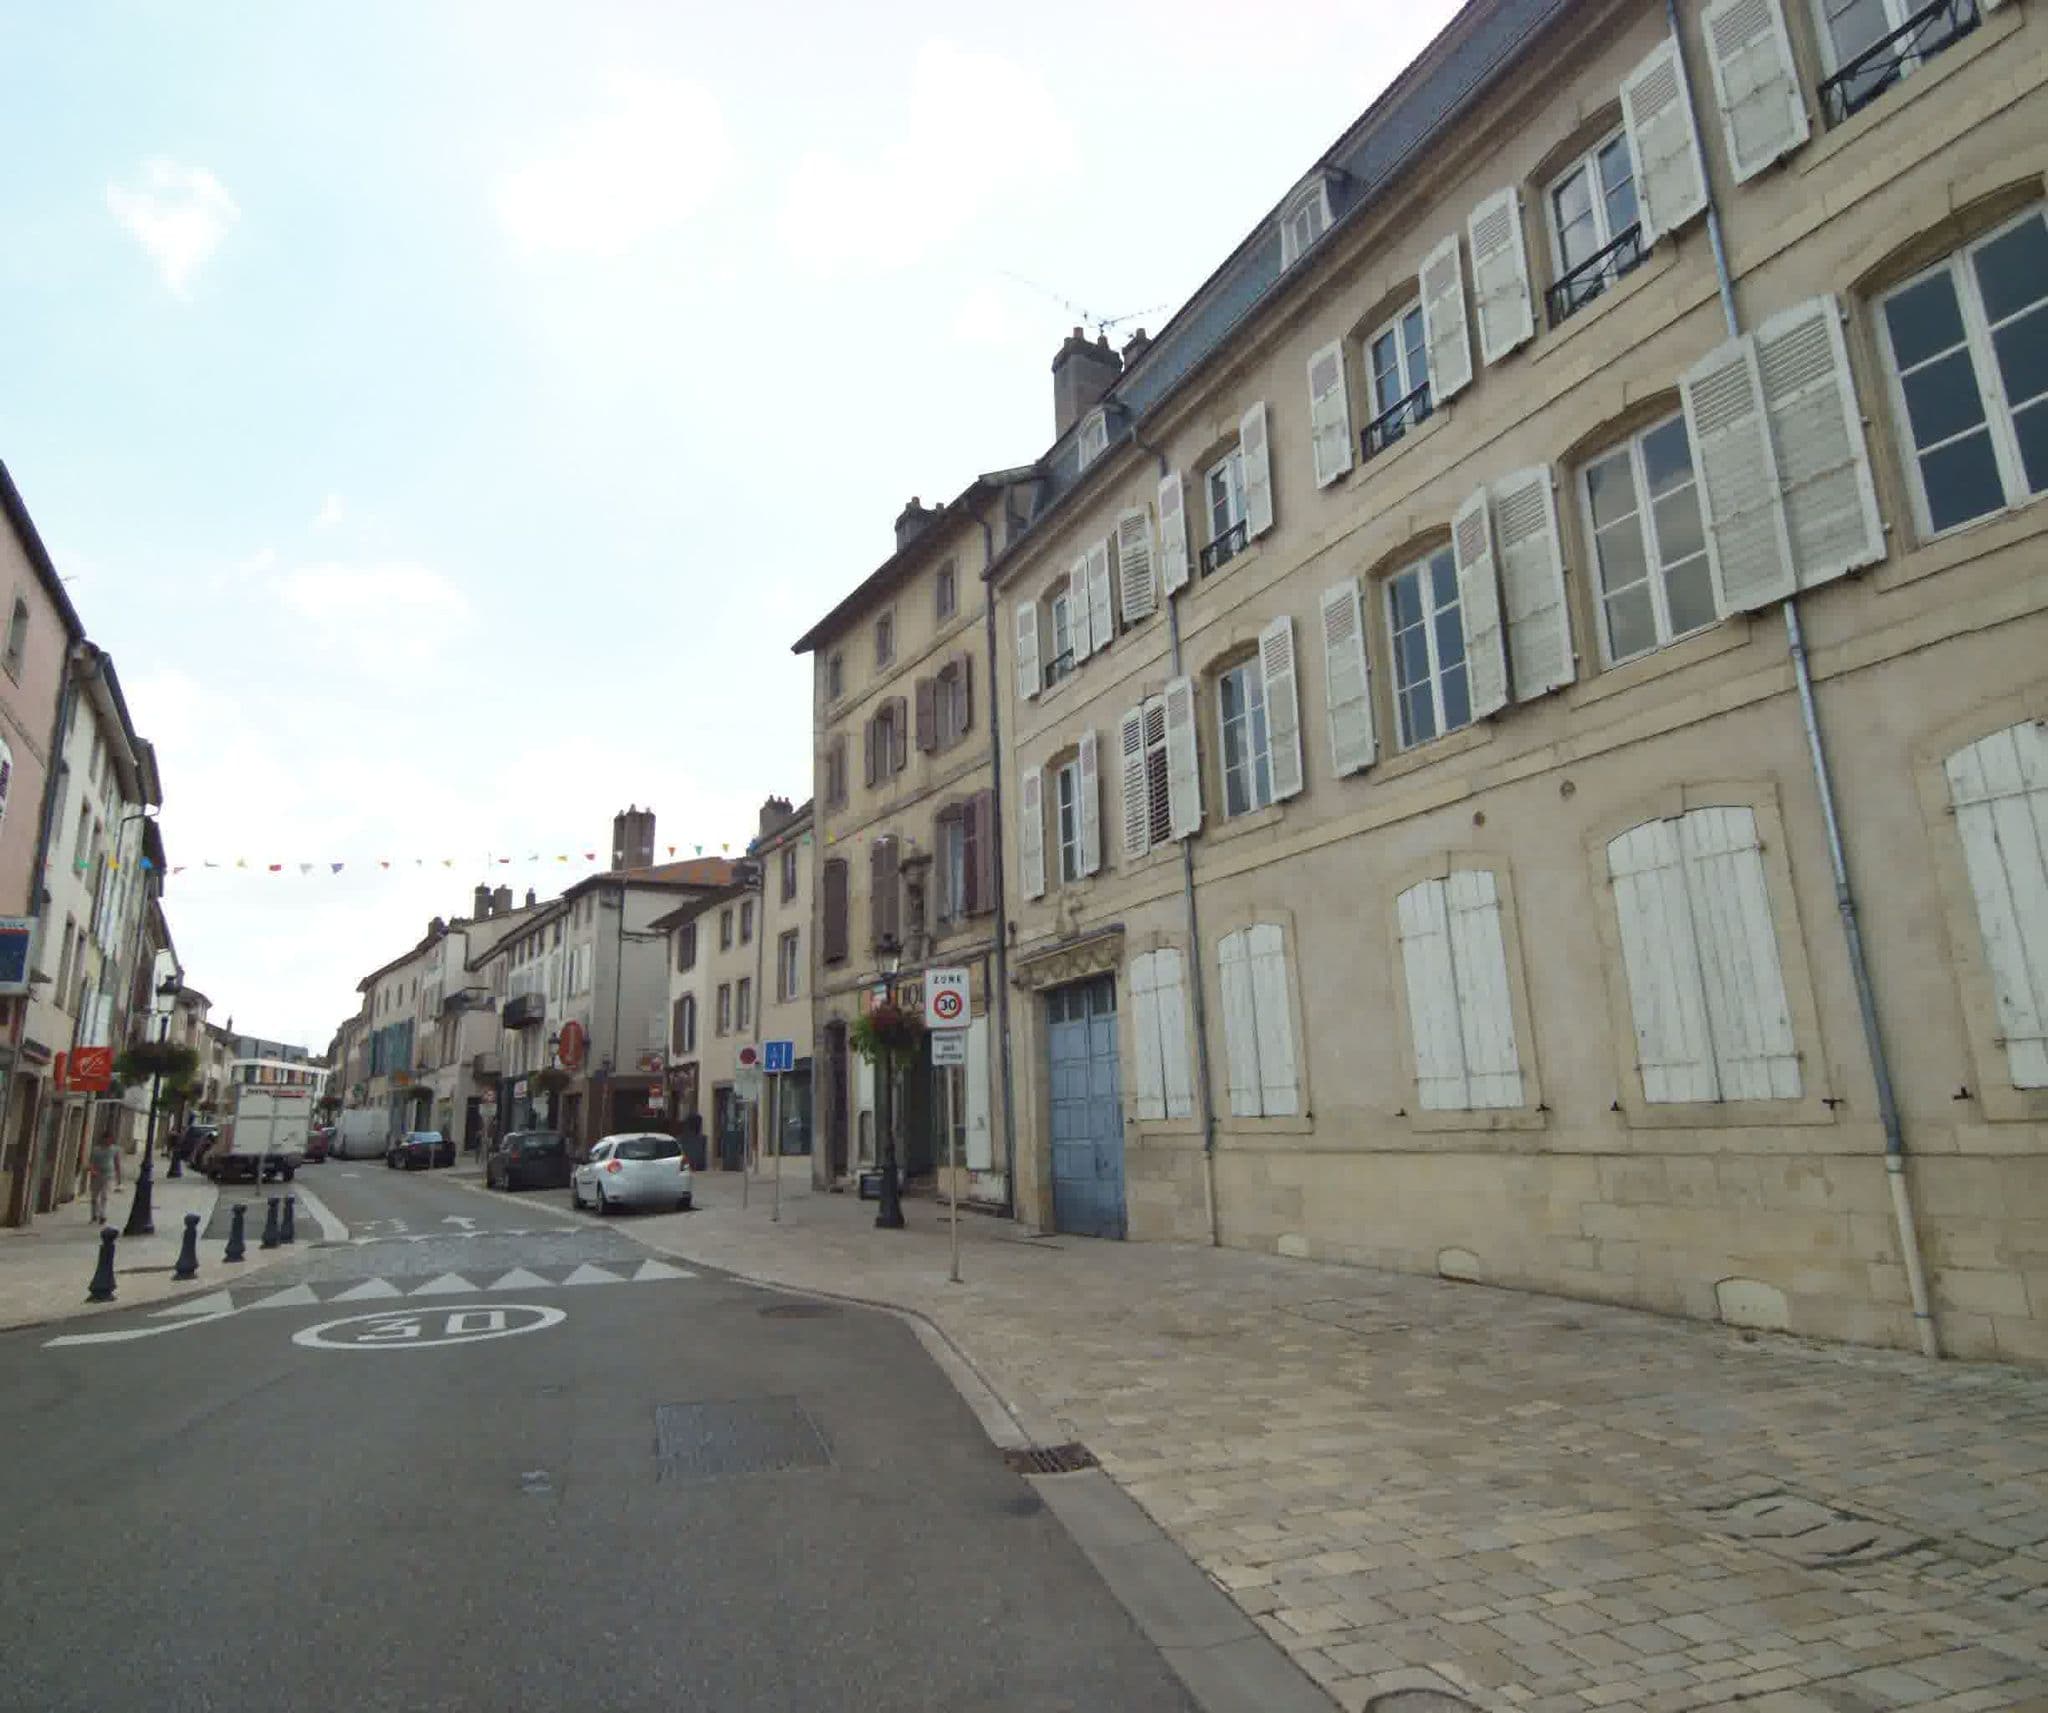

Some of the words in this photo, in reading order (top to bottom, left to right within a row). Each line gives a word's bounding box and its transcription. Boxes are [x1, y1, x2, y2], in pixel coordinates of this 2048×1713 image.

[933, 975, 962, 985] ZONE
[940, 998, 957, 1011] 30
[357, 1310, 506, 1341] 30
